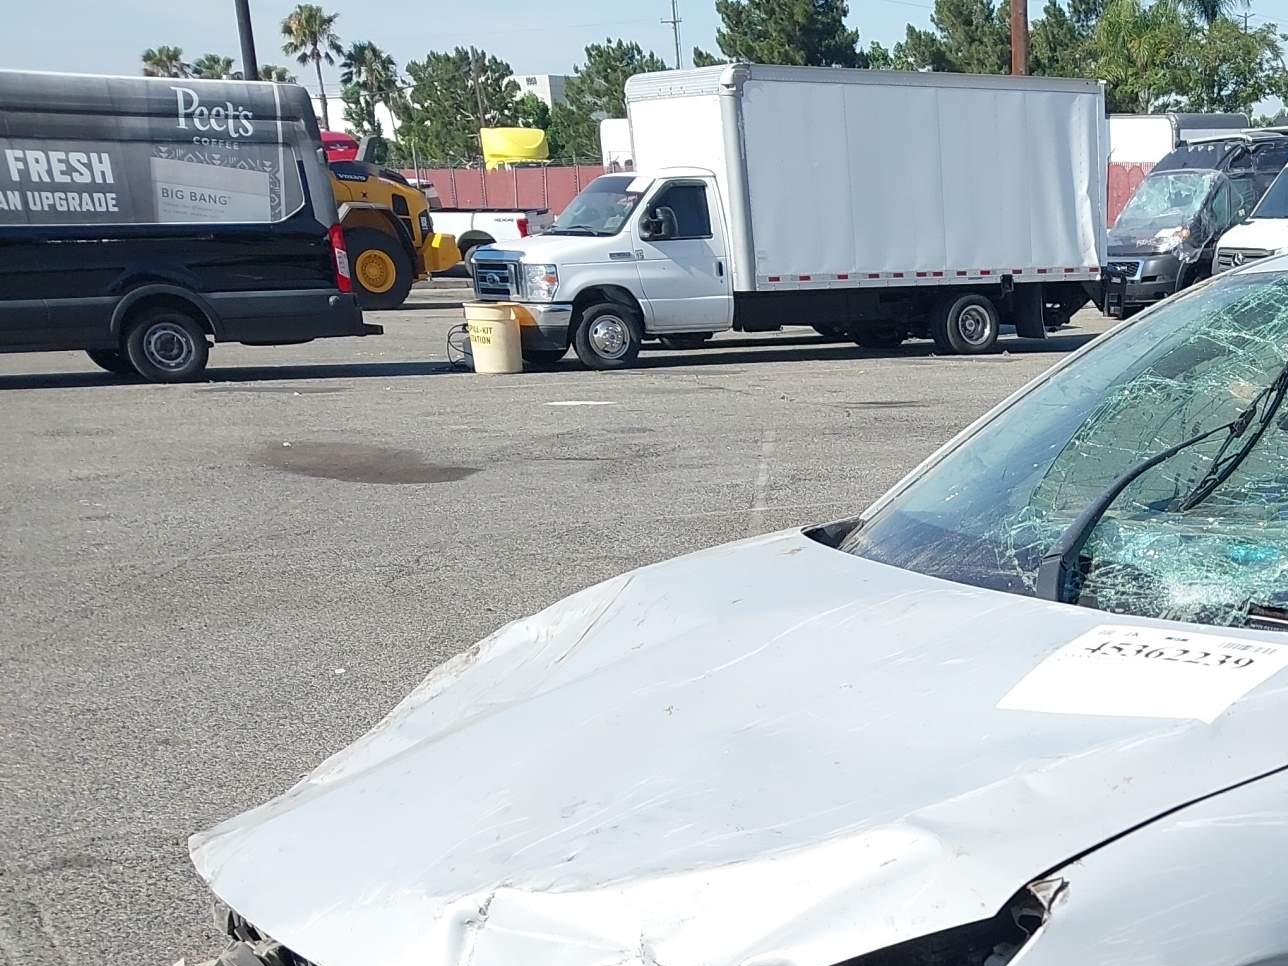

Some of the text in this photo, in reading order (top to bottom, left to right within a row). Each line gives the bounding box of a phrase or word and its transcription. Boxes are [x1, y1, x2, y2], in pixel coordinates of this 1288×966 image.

[170, 86, 254, 137] Peet's
[193, 136, 240, 150] COFFEE
[4, 149, 114, 184] FRESH
[26, 191, 119, 212] UPGRADE
[161, 187, 228, 206] BIG BANG
[1085, 641, 1254, 669] 45362239
